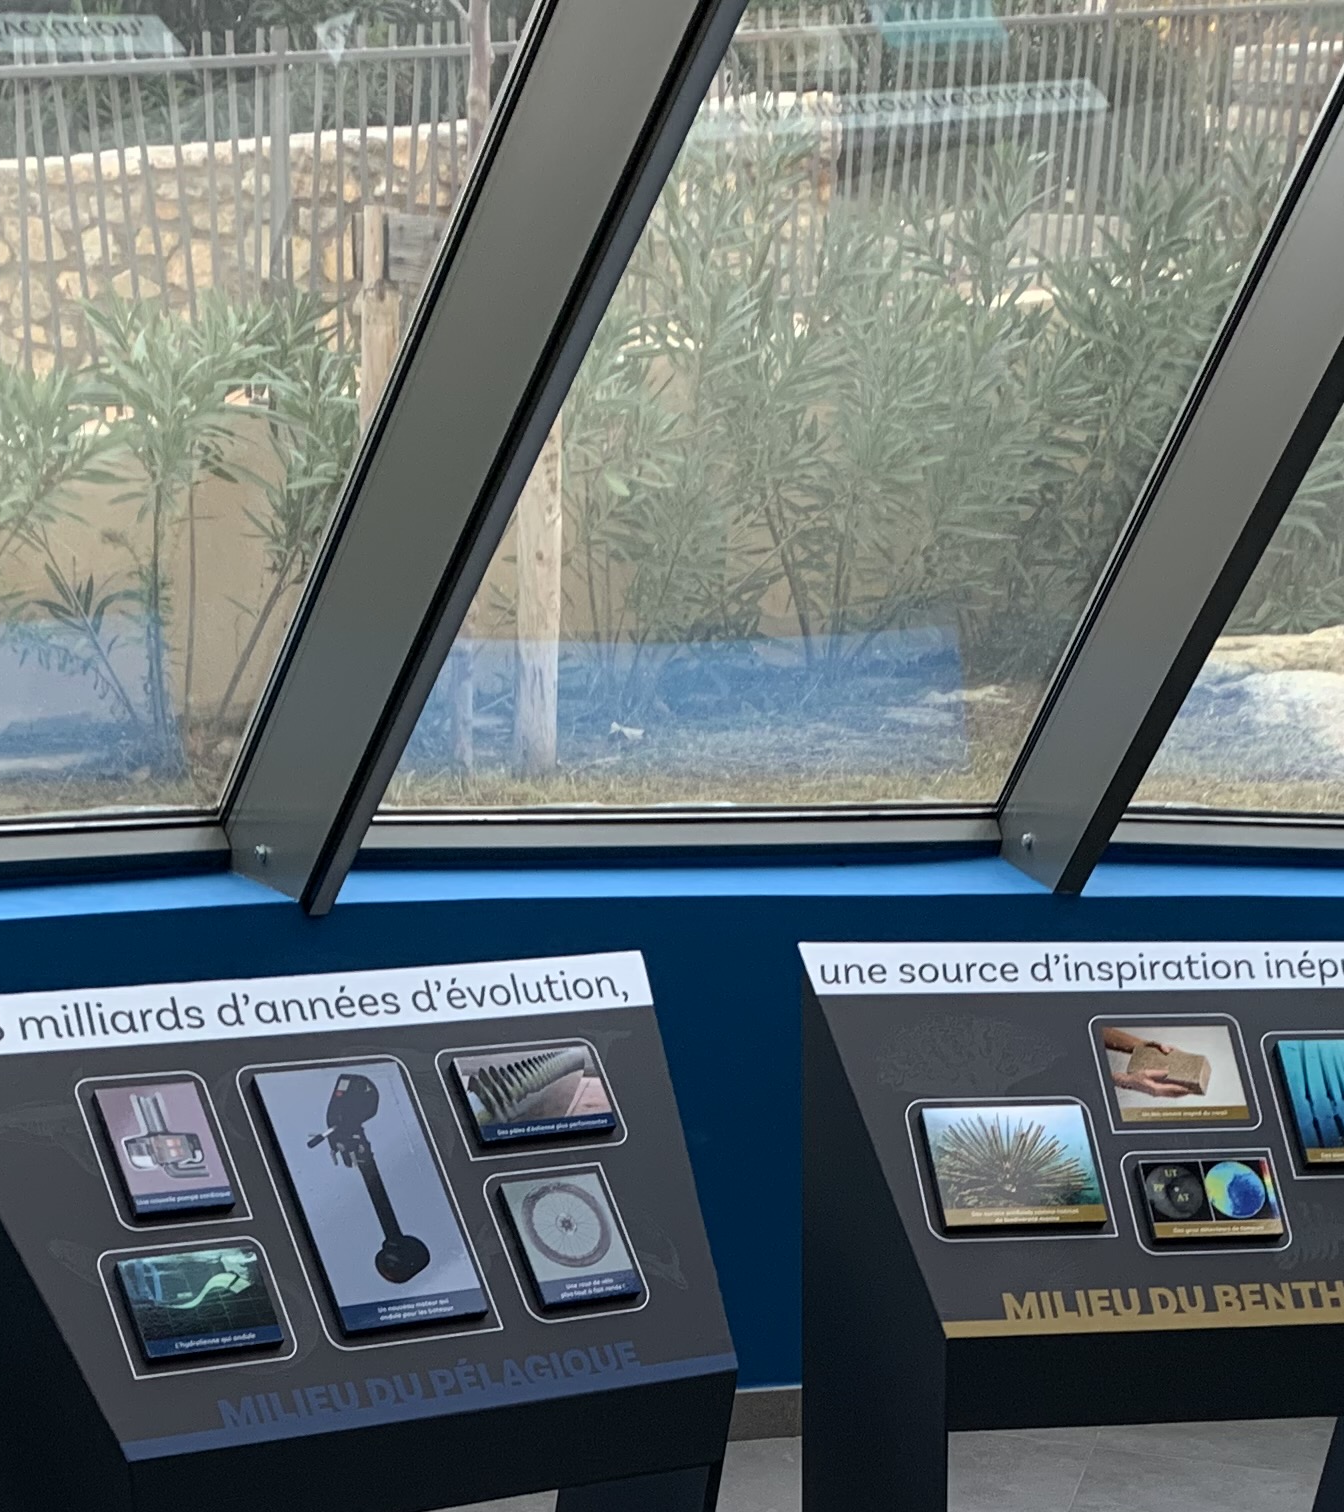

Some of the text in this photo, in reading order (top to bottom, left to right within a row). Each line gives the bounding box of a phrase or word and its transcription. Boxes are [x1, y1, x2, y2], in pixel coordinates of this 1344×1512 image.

[820, 962, 887, 985] une
[899, 962, 1019, 984] source
[1030, 952, 1256, 989] d'inspiration
[18, 1001, 205, 1041] milliards
[217, 985, 401, 1027] d'années
[411, 970, 629, 1013] d'évolution,
[1001, 1287, 1141, 1321] MILIEU
[1149, 1285, 1204, 1314] DU
[217, 1340, 641, 1430] MILIEU DU PÉLAGIQUE
